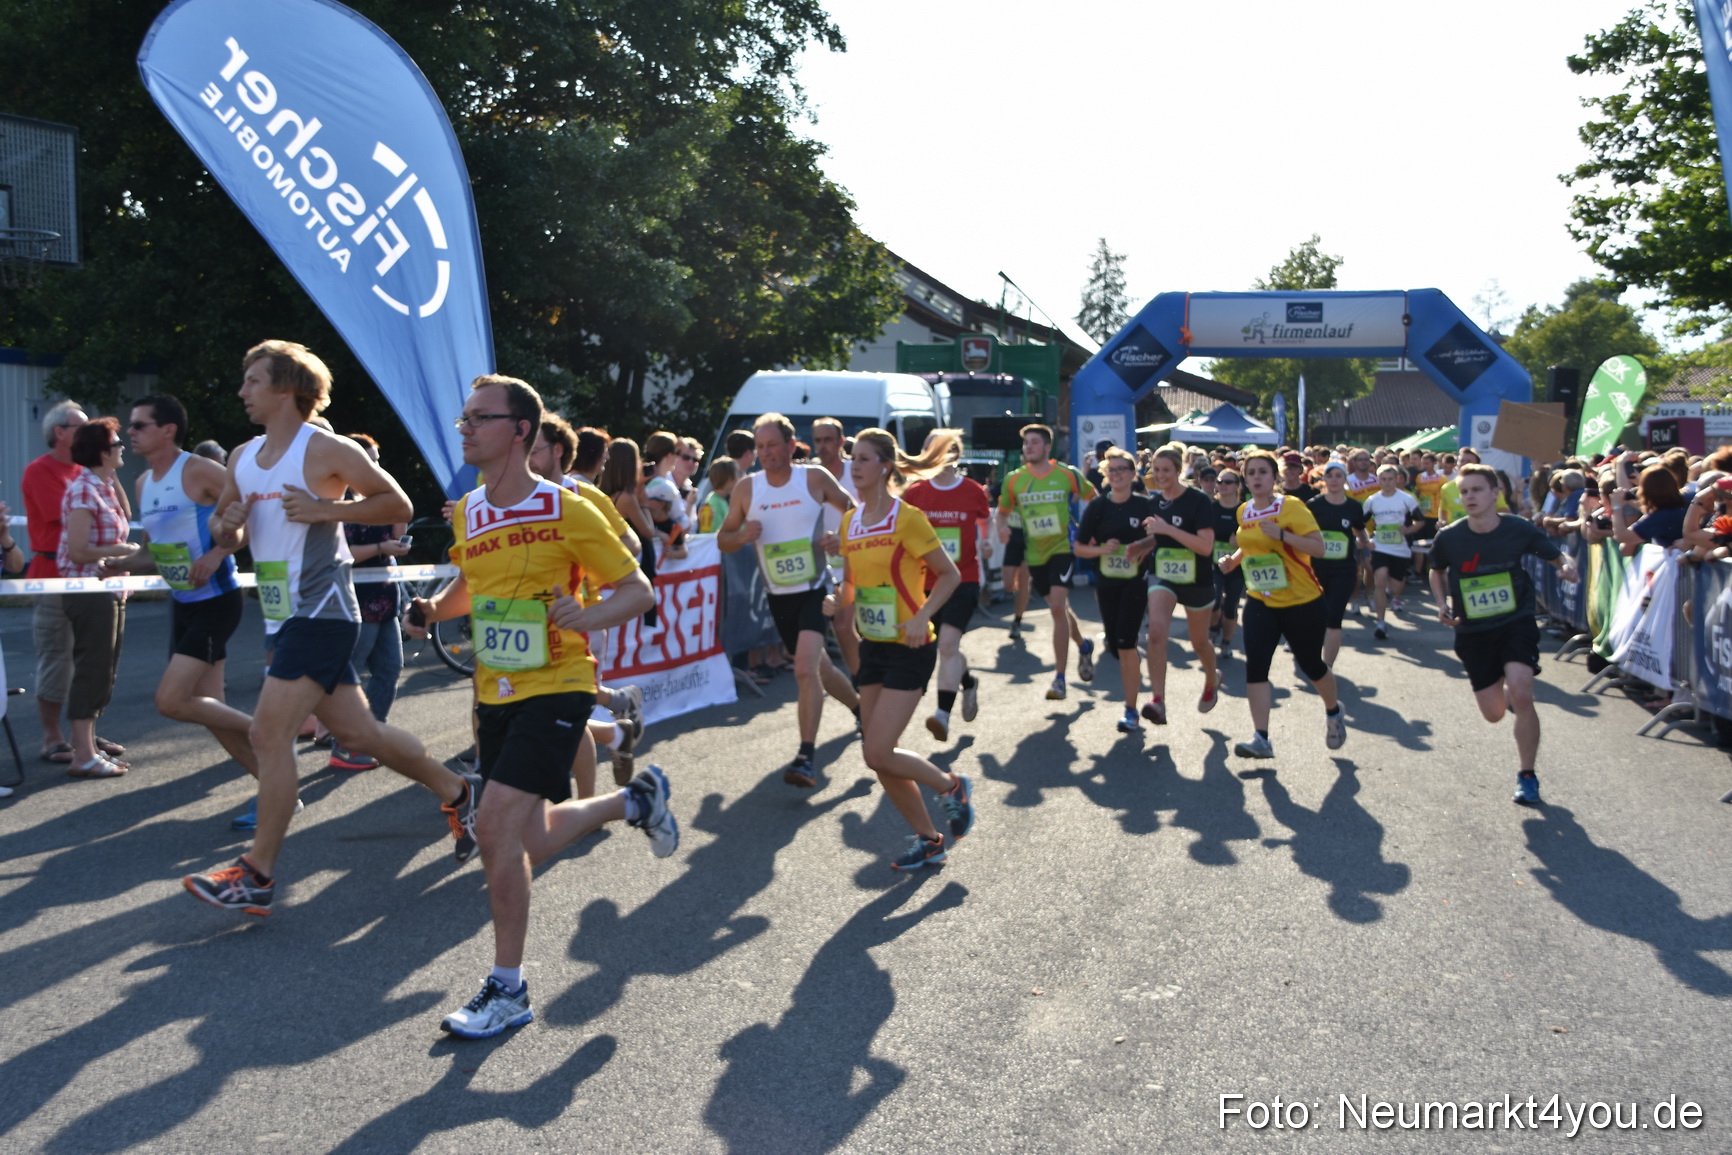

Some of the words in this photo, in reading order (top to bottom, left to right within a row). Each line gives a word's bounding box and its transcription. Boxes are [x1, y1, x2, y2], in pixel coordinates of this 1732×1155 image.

[1272, 323, 1354, 338] firmenlauf
[1120, 352, 1163, 362] Fischer
[1653, 406, 1686, 416] Jura
[1581, 411, 1611, 443] AOK
[1651, 427, 1671, 442] RW
[926, 510, 959, 519] UMARKT
[1032, 517, 1053, 528] 144
[466, 536, 502, 560] MAX
[508, 526, 565, 547] BÖGL
[776, 556, 805, 574] 583
[1163, 562, 1187, 574] 324
[1252, 568, 1278, 581] 912
[1468, 589, 1509, 607] 1419
[859, 606, 886, 625] 894
[485, 626, 529, 652] 870
